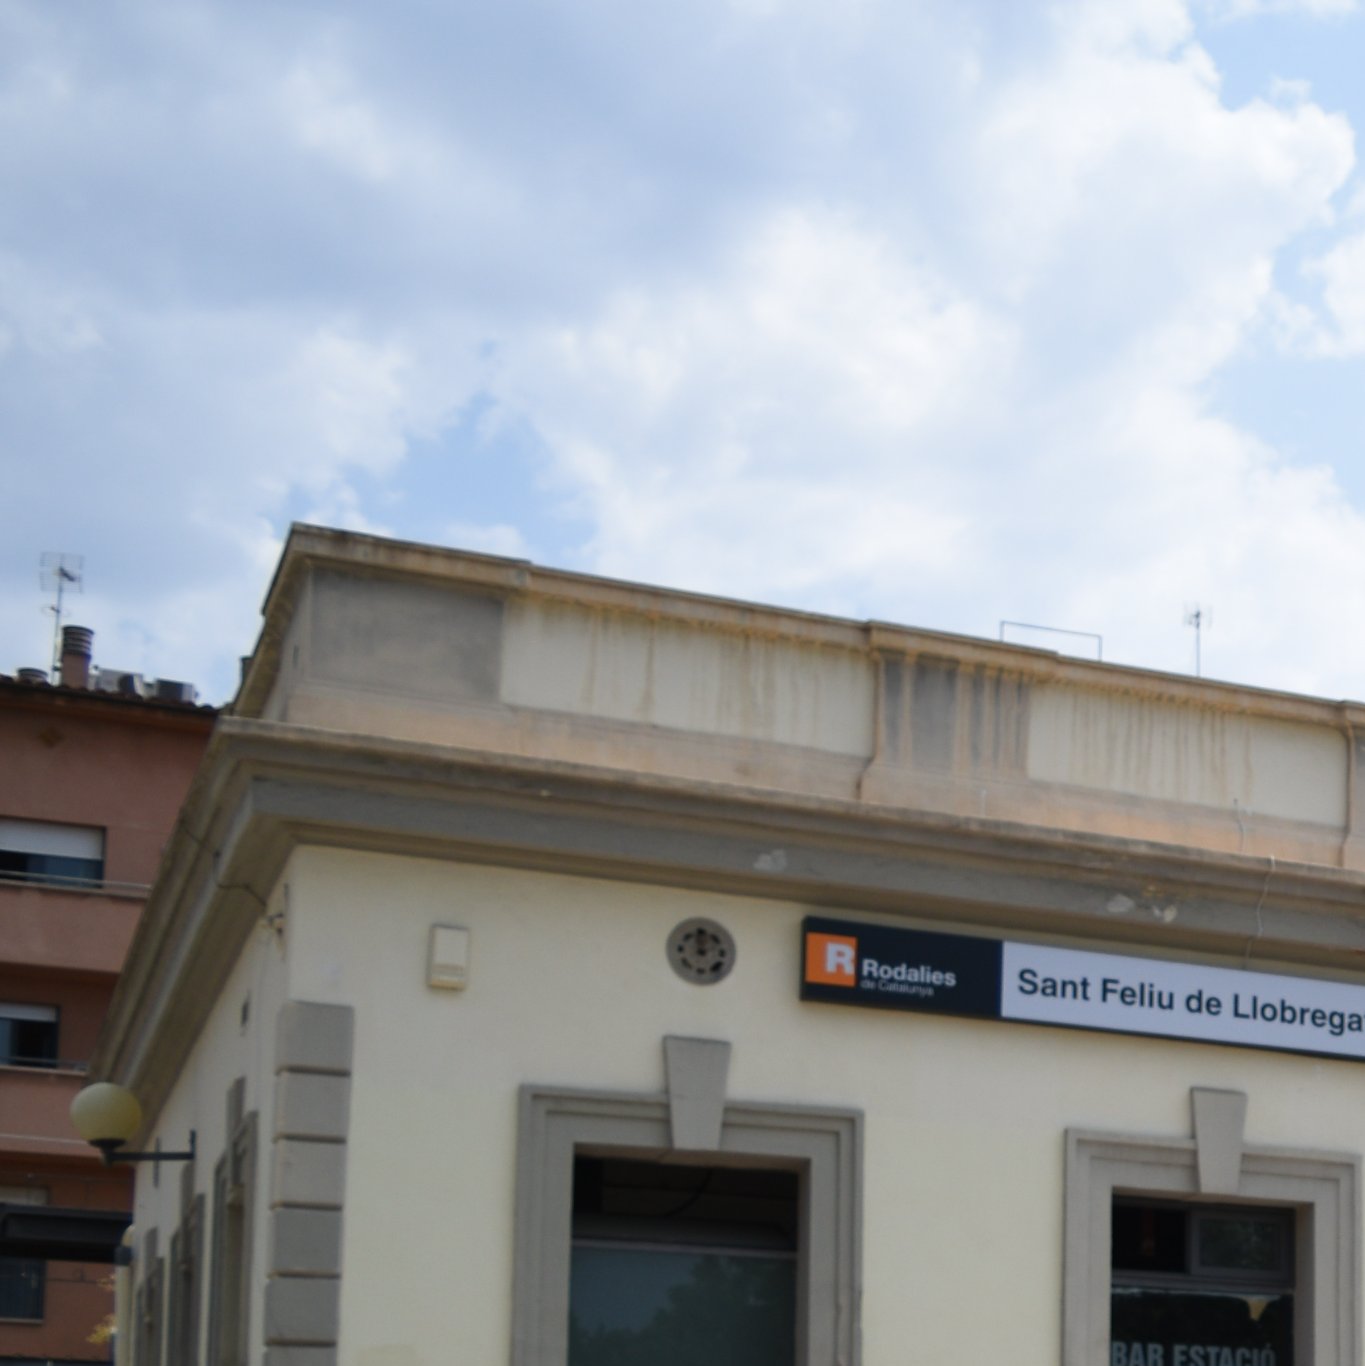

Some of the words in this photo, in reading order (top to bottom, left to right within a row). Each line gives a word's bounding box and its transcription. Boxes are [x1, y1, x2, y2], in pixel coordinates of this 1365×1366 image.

[861, 958, 957, 987] Rodalies
[1017, 968, 1091, 1002] Sant
[1101, 978, 1175, 1011] Feliu
[1185, 990, 1223, 1016] de
